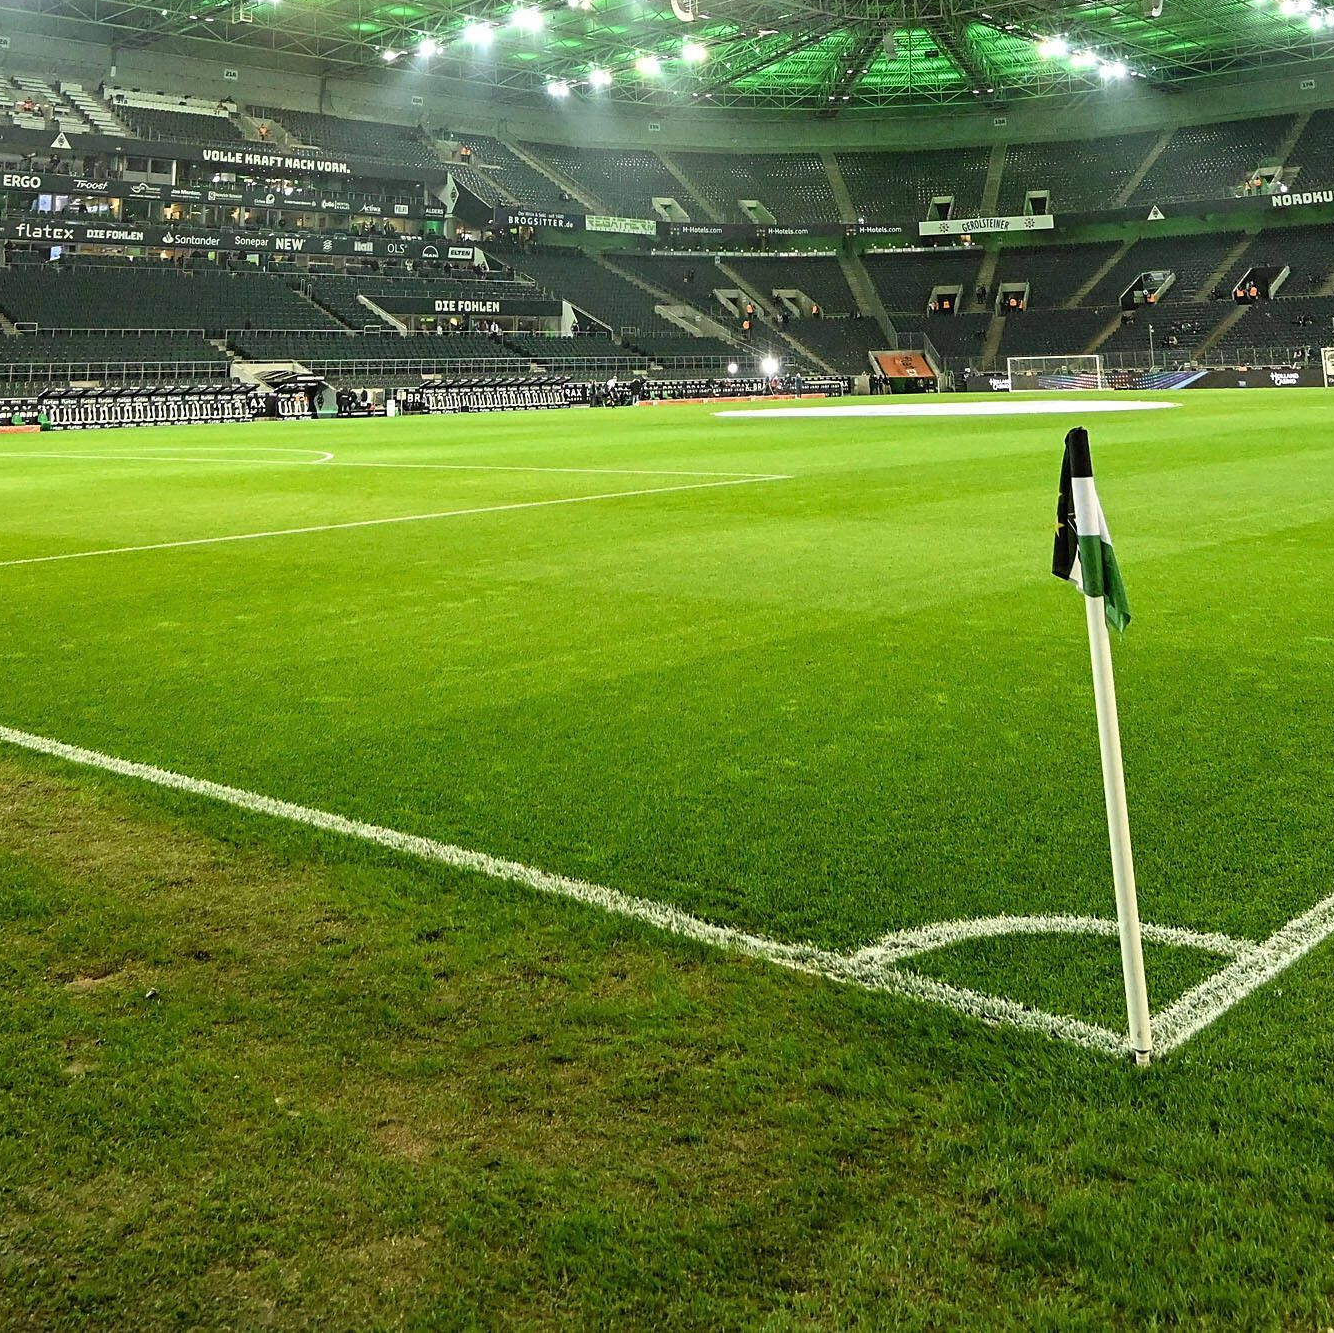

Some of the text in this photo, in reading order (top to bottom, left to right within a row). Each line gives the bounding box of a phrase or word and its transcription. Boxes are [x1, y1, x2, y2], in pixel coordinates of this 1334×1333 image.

[203, 150, 351, 174] VOLLE KRAFT NACH VORN.
[3, 174, 41, 189] ERGO
[73, 179, 109, 190] Troost
[682, 226, 723, 234] H-Hotels.com
[768, 227, 809, 235] H-Hotels.com
[859, 226, 902, 235] H-Hotels.com
[961, 219, 1011, 233] GEROLSTEINER
[86, 229, 144, 241] DIE FOHLEN
[175, 234, 220, 246] Santander
[234, 235, 269, 247] Sonepar
[275, 237, 303, 251] NEW
[387, 243, 405, 254] OLS
[434, 300, 500, 313] DIE FOHLEN
